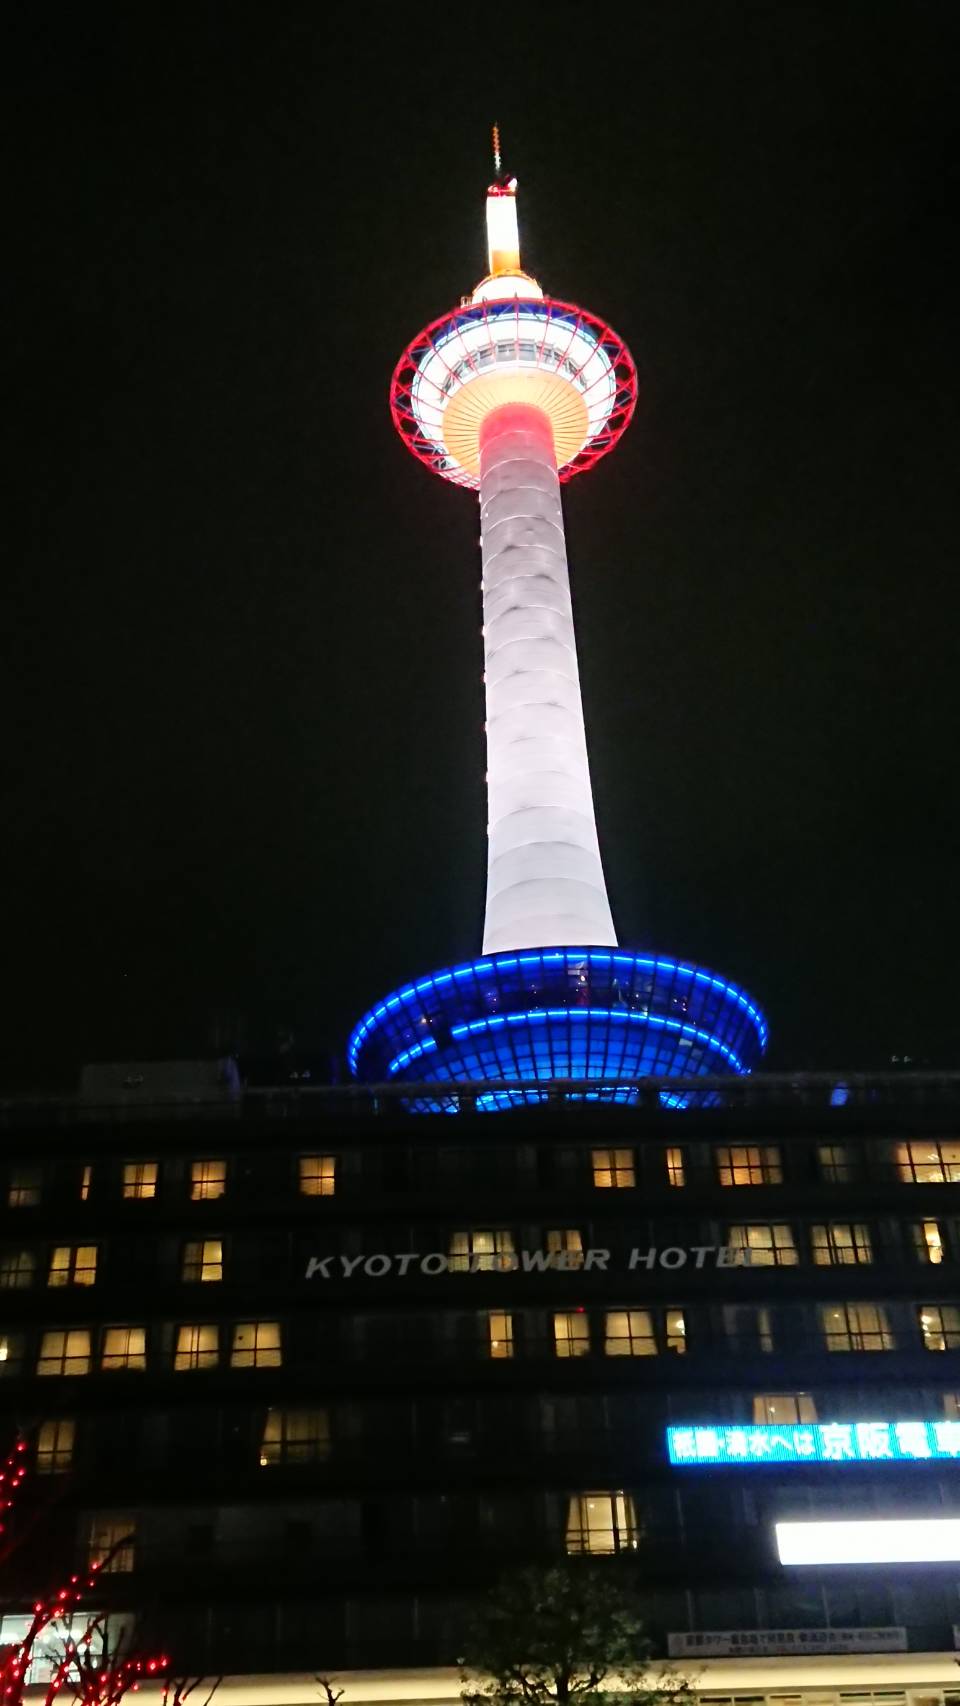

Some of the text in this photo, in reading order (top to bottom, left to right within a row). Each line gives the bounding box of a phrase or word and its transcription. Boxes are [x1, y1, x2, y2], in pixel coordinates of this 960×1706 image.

[305, 1246, 767, 1279] KYOTO TOWER HOTEL
